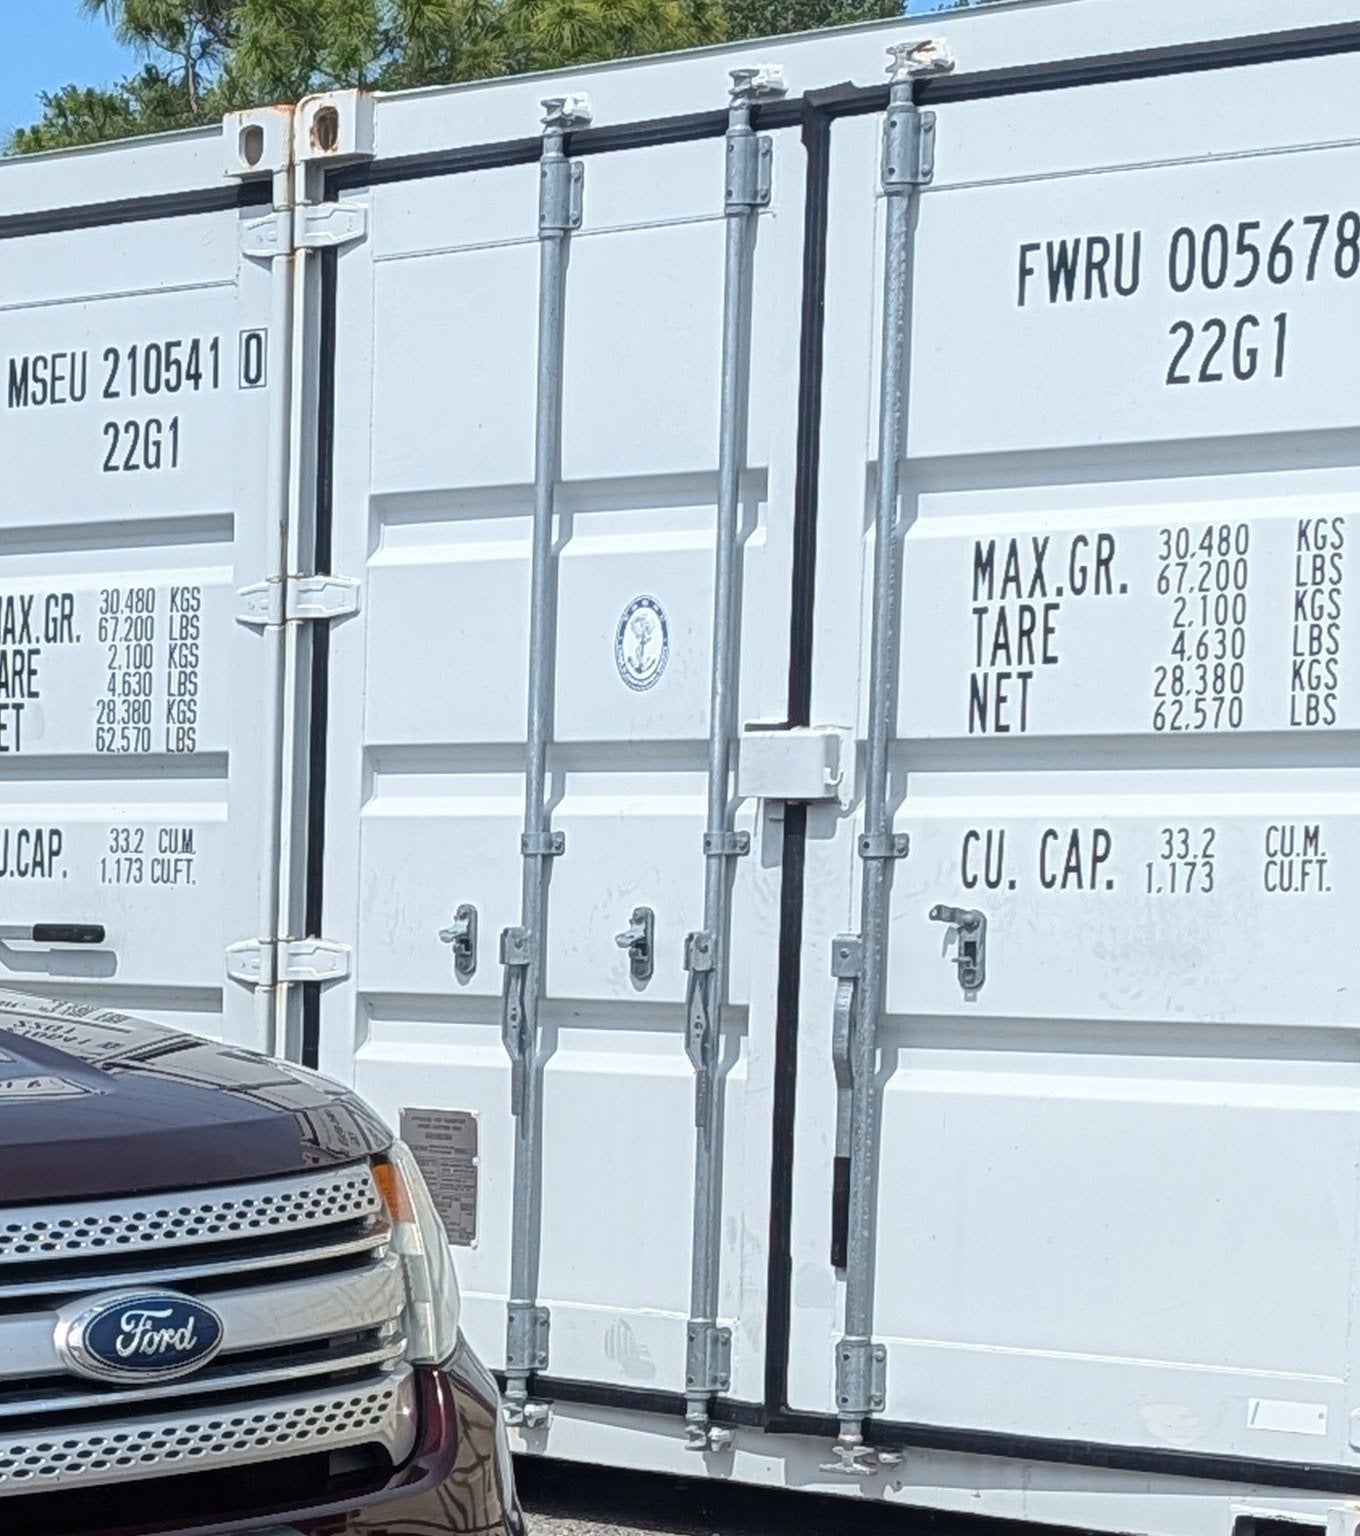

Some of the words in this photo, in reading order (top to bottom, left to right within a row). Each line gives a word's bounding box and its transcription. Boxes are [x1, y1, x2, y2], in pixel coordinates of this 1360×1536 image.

[1017, 231, 1141, 307] FWRU
[1168, 210, 1360, 293] 005678
[1165, 312, 1288, 386] 22G1
[8, 351, 87, 408] MSEU
[102, 336, 220, 399] 210541
[243, 332, 263, 385] 0
[103, 416, 179, 472] 22G1
[1297, 517, 1346, 552] KGS
[973, 533, 1128, 602] MAX.GR.
[1295, 553, 1343, 587] LBS
[170, 586, 201, 613] KGS
[1294, 588, 1342, 622] KGS
[169, 614, 200, 641] LBS
[972, 602, 1060, 668] TARE
[1292, 622, 1341, 657] LBS
[168, 643, 199, 669] KGS
[167, 670, 198, 697] LBS
[1291, 657, 1339, 692] KGS
[166, 699, 197, 725] KGS
[969, 671, 1034, 734] NET
[1290, 692, 1338, 727] LBS
[166, 727, 196, 753] LBS
[1160, 827, 1216, 860] 33.2
[116, 1308, 197, 1358] Ford
